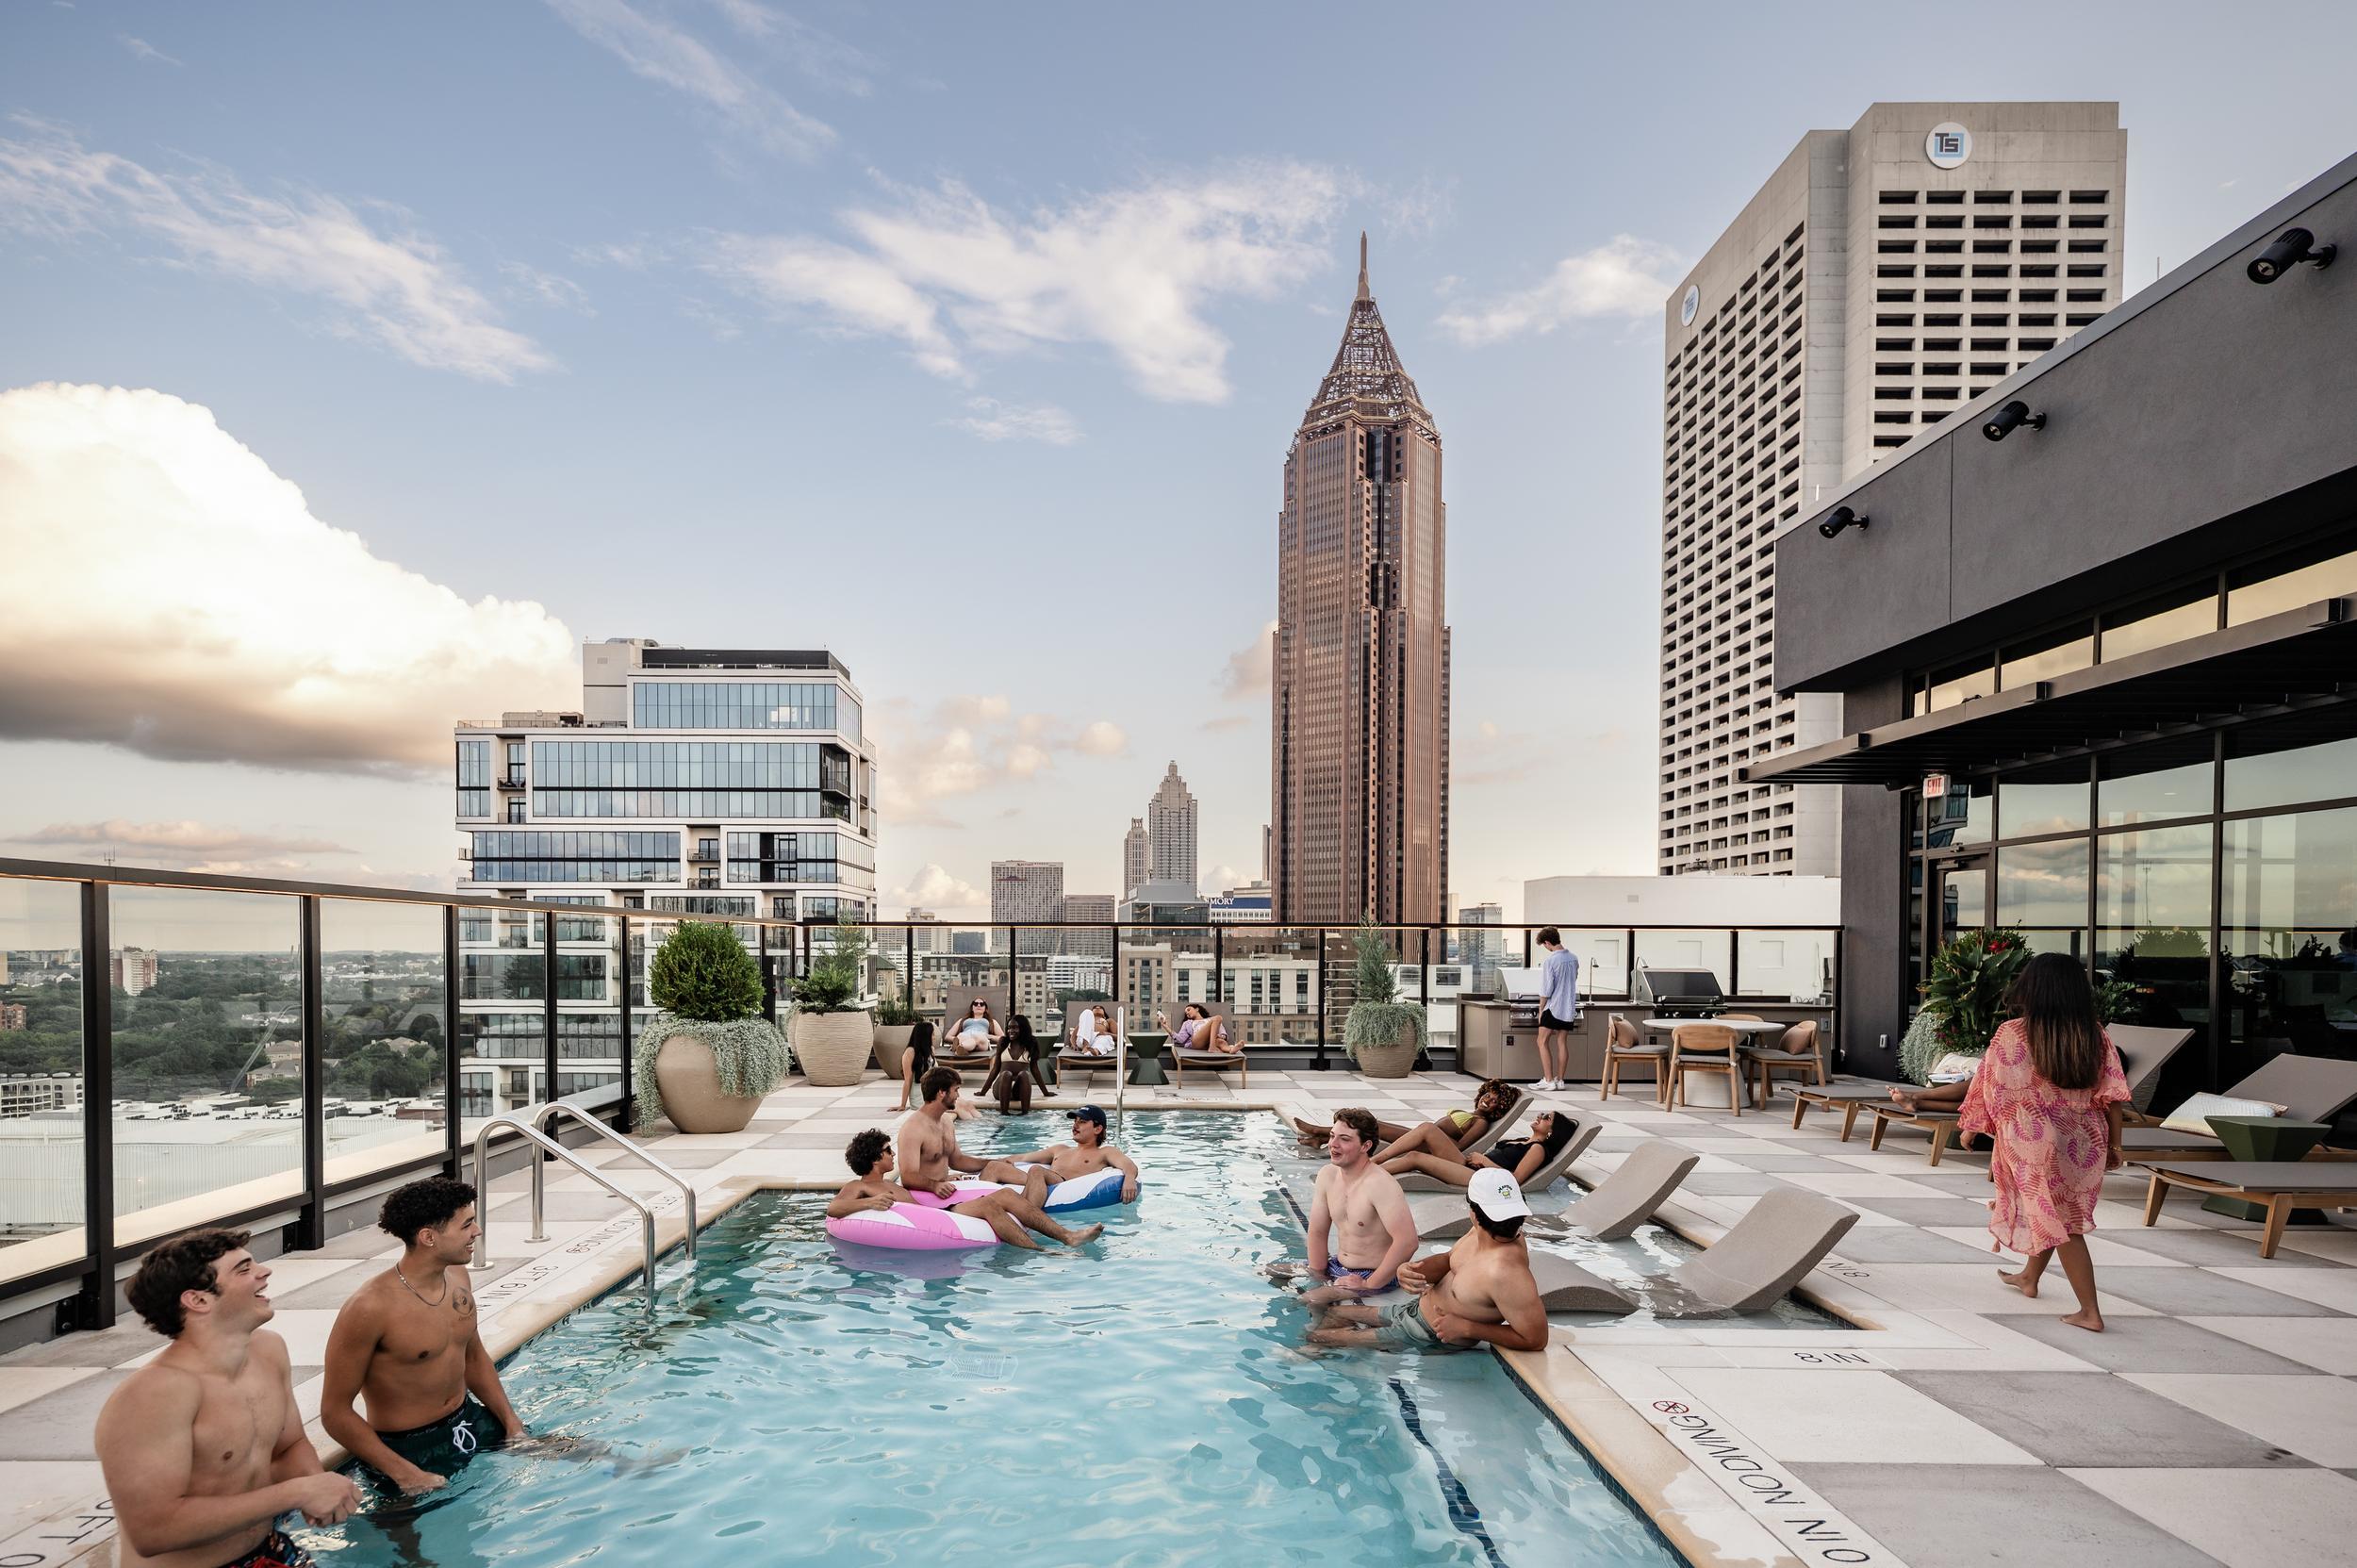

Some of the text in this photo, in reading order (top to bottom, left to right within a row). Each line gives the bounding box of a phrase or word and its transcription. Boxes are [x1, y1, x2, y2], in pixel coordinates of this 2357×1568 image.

[1935, 132, 1959, 153] TS
[1793, 1351, 1871, 1364] 8 IN
[1669, 1414, 1764, 1471] DIVING
[1738, 1474, 1806, 1505] NO
[38, 1515, 115, 1545] FT
[1784, 1519, 1849, 1542] IN
